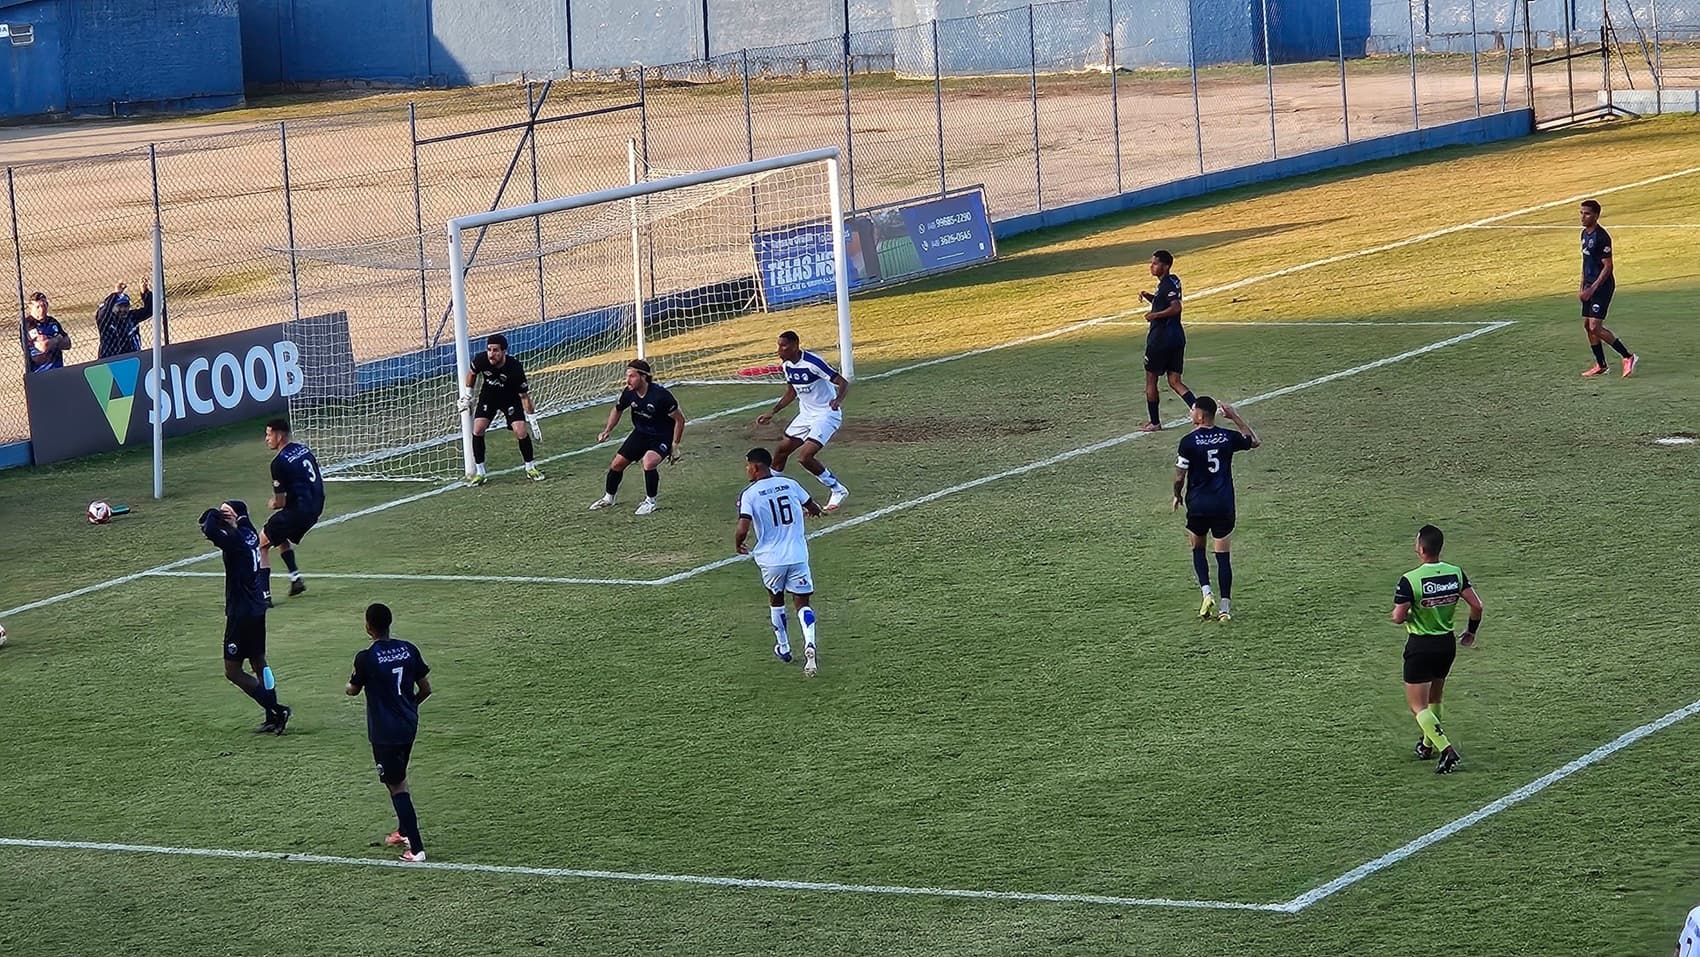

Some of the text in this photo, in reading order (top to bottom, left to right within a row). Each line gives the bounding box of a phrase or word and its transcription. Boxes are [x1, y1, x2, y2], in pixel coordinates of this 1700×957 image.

[145, 340, 304, 425] SICOOB
[302, 459, 317, 482] 3
[1207, 449, 1221, 473] 5
[768, 495, 794, 527] 16
[392, 666, 404, 696] 7
